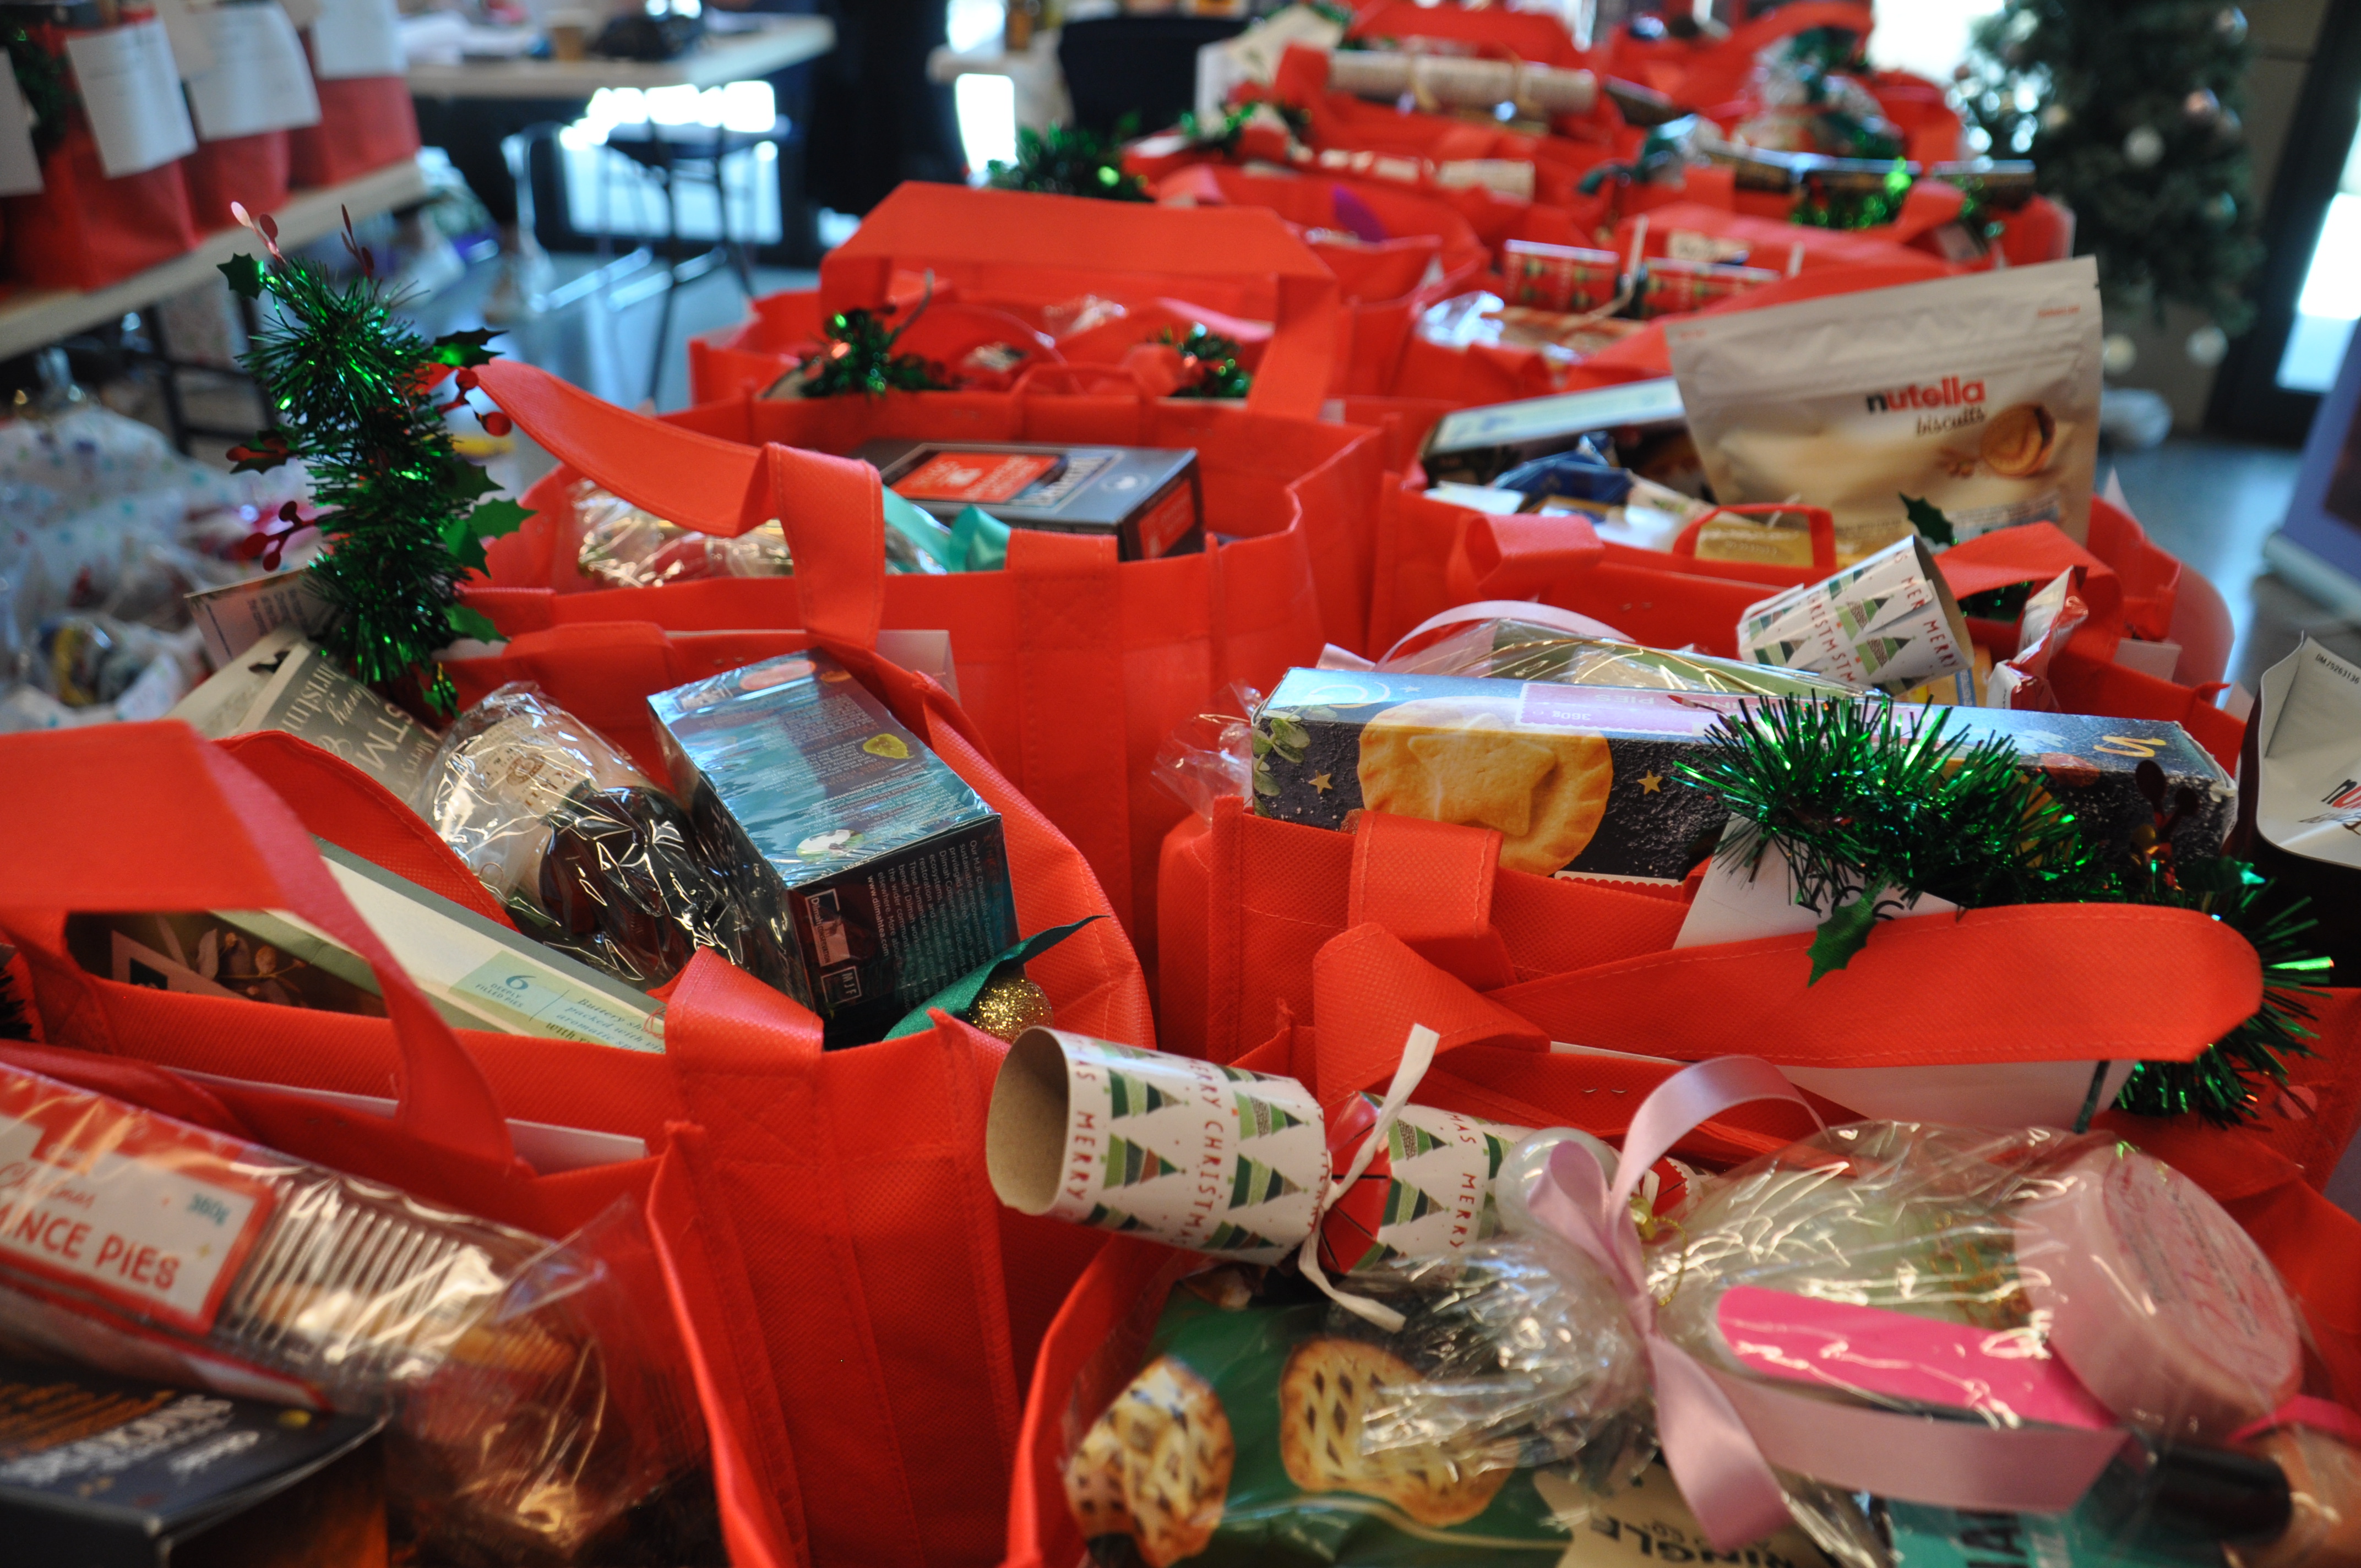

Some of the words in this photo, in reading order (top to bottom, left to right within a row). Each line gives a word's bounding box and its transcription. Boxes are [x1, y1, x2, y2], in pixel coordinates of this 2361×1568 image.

[1867, 376, 1985, 412] nutella
[1916, 408, 1987, 436] biscuits
[1923, 619, 1959, 668] MERRY
[1595, 694, 1654, 705] PIES
[938, 849, 951, 880] Dilmah
[969, 839, 979, 856] Our
[972, 856, 982, 874] MJF
[887, 867, 897, 883] the
[908, 860, 920, 886] These
[947, 845, 964, 888] privileged
[890, 882, 903, 907] wider
[897, 863, 911, 894] benefit
[904, 894, 917, 924] Dilmah
[918, 856, 933, 902] restoration
[927, 902, 937, 919] and
[959, 842, 973, 889] sustainable
[967, 889, 984, 946] empowerment
[976, 874, 989, 916] Charitable
[809, 896, 825, 925] Dilmah
[866, 874, 890, 957] www.dilmahtea.com
[913, 885, 931, 939] humanitarian
[944, 879, 961, 933] Conservation
[816, 924, 831, 964] CONSERVATION
[886, 915, 897, 937] More
[895, 907, 912, 953] community
[938, 903, 951, 938] heritage
[945, 937, 954, 953] and
[924, 939, 934, 955] and
[505, 975, 536, 990] 6
[841, 971, 857, 995] MJF
[556, 1013, 614, 1041] aromatic
[564, 1006, 614, 1033] packed
[614, 1027, 643, 1043] with
[578, 998, 625, 1022] Buttery
[546, 1022, 575, 1040] with
[1066, 1110, 1096, 1201] MERRY
[1449, 1172, 1477, 1250] MERRY
[95, 1233, 181, 1291] PIES
